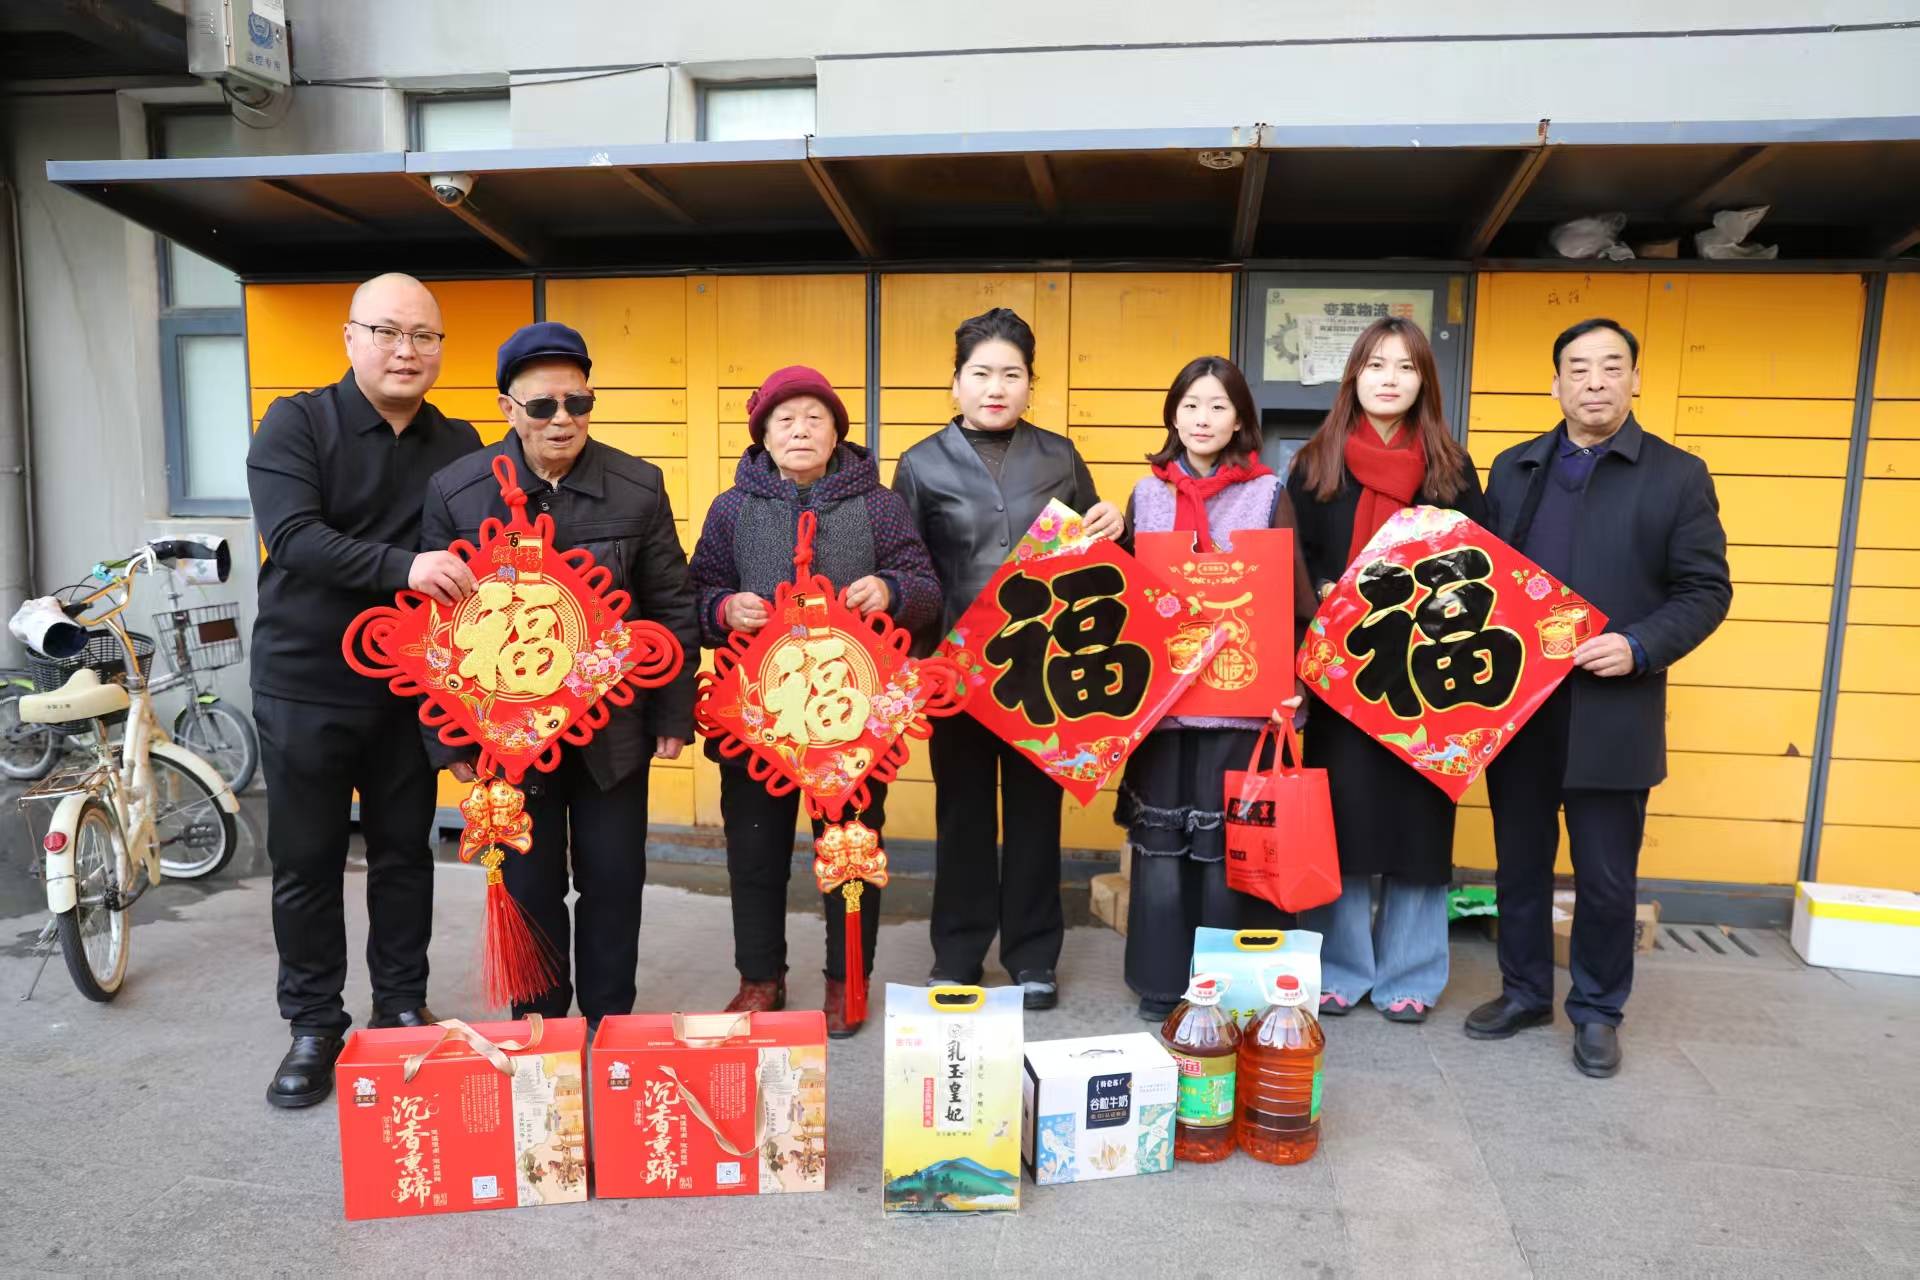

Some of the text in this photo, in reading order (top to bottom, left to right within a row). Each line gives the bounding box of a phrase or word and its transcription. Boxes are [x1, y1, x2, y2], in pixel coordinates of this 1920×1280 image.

[453, 580, 574, 696] 福
[984, 562, 1153, 728] 福
[1345, 546, 1525, 720] 福
[763, 638, 872, 745] 福
[945, 1039, 966, 1122] 乳玉皇妃
[1090, 1094, 1129, 1111] 谷粒牛奶
